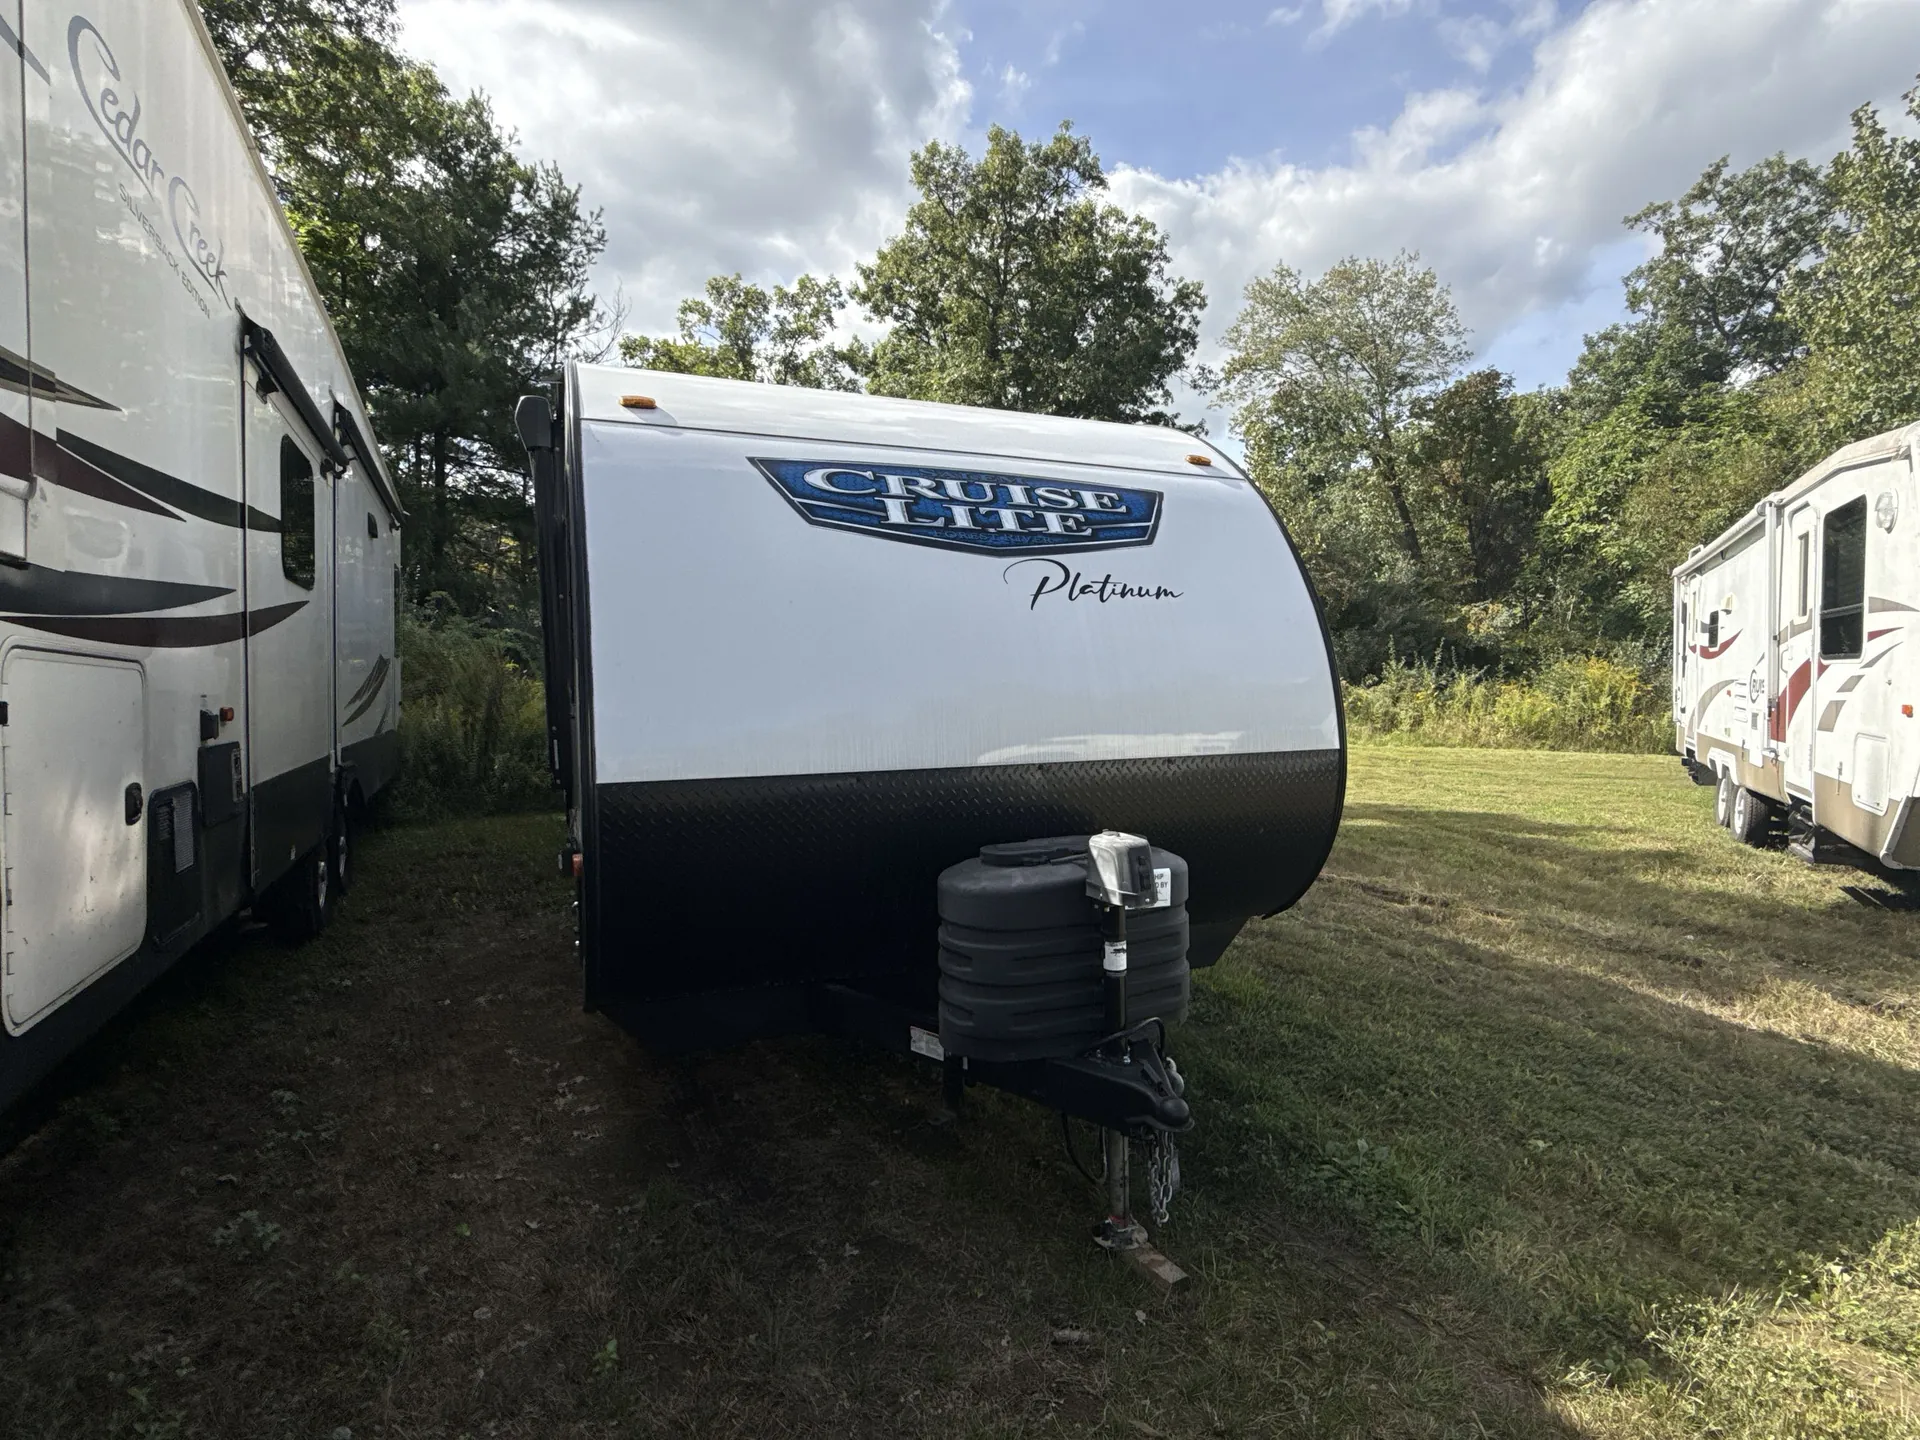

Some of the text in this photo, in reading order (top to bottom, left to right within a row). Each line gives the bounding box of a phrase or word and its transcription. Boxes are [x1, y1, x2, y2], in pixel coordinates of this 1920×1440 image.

[67, 15, 232, 311] Cedar Creek
[119, 182, 211, 320] SILVERBACK EDITION
[803, 467, 1127, 513] CRUISE
[918, 467, 1026, 485] SALEM
[874, 496, 1093, 537] LITE
[932, 530, 1055, 544] FOREST RIVER
[1003, 558, 1184, 611] Platinum
